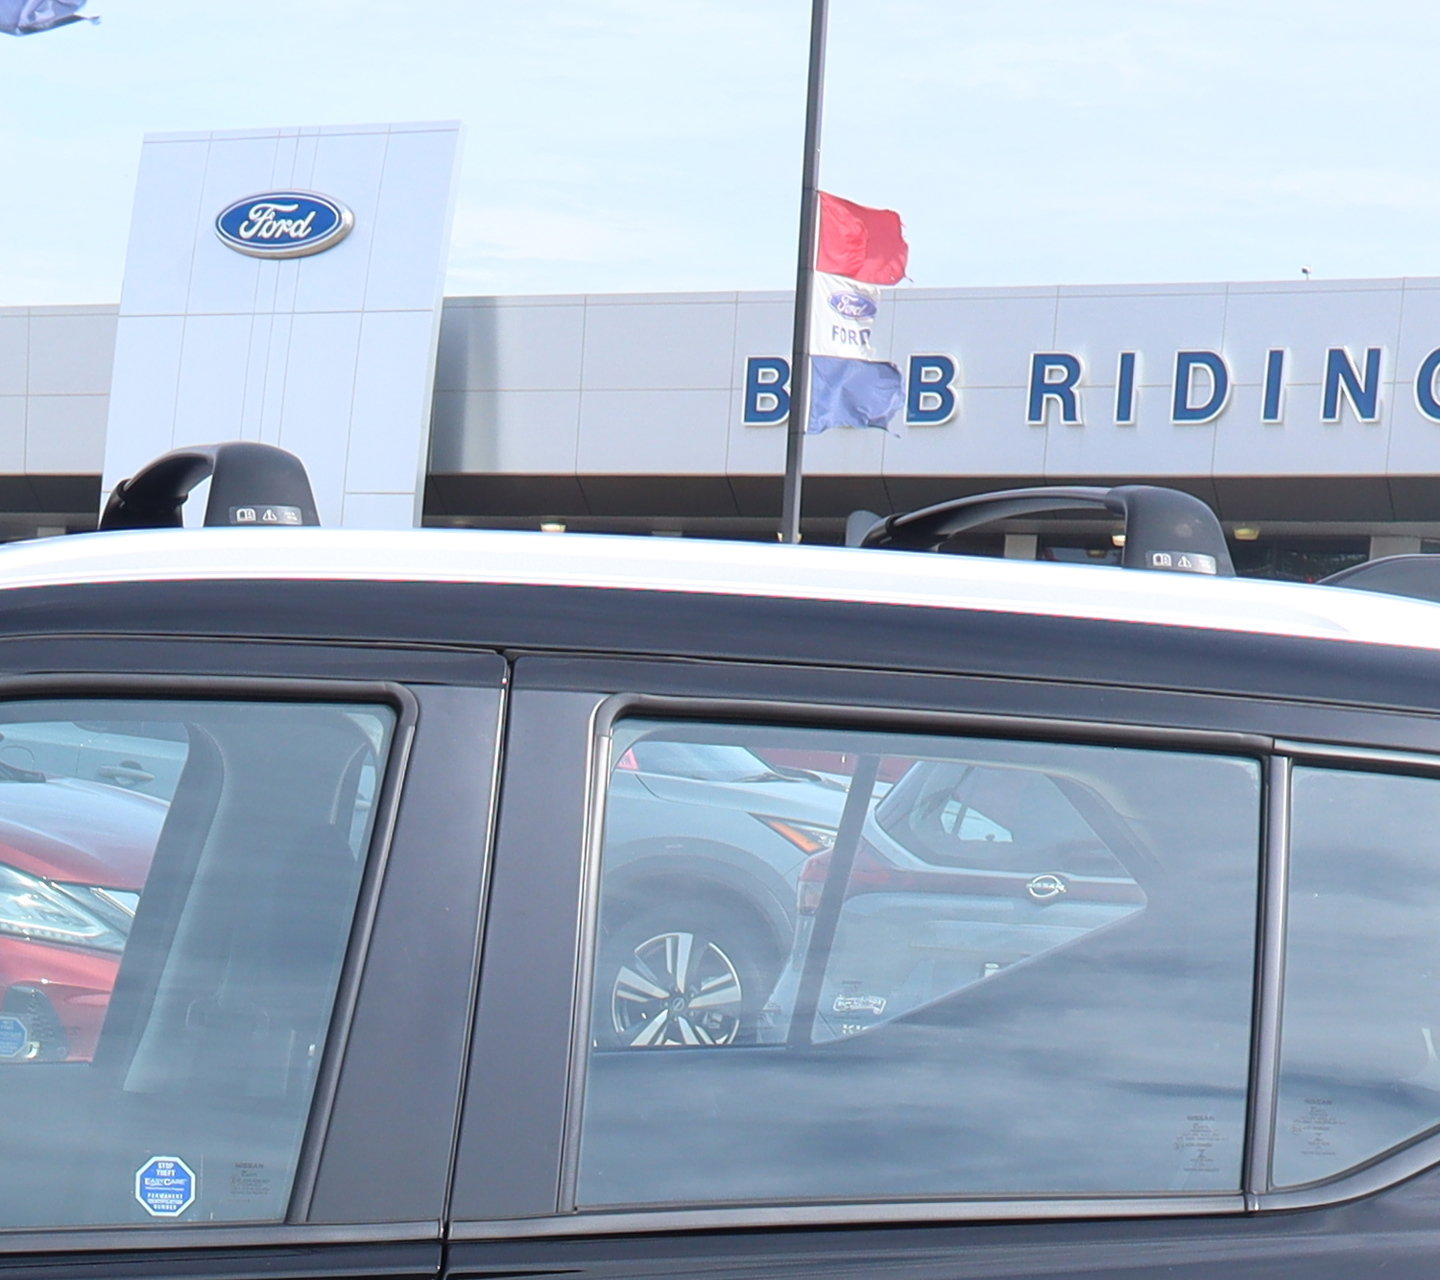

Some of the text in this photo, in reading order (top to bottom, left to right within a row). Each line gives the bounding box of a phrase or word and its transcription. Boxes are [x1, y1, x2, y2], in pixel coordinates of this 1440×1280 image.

[239, 202, 316, 239] Ford
[742, 354, 959, 427] BB
[155, 1169, 176, 1177] THEFT
